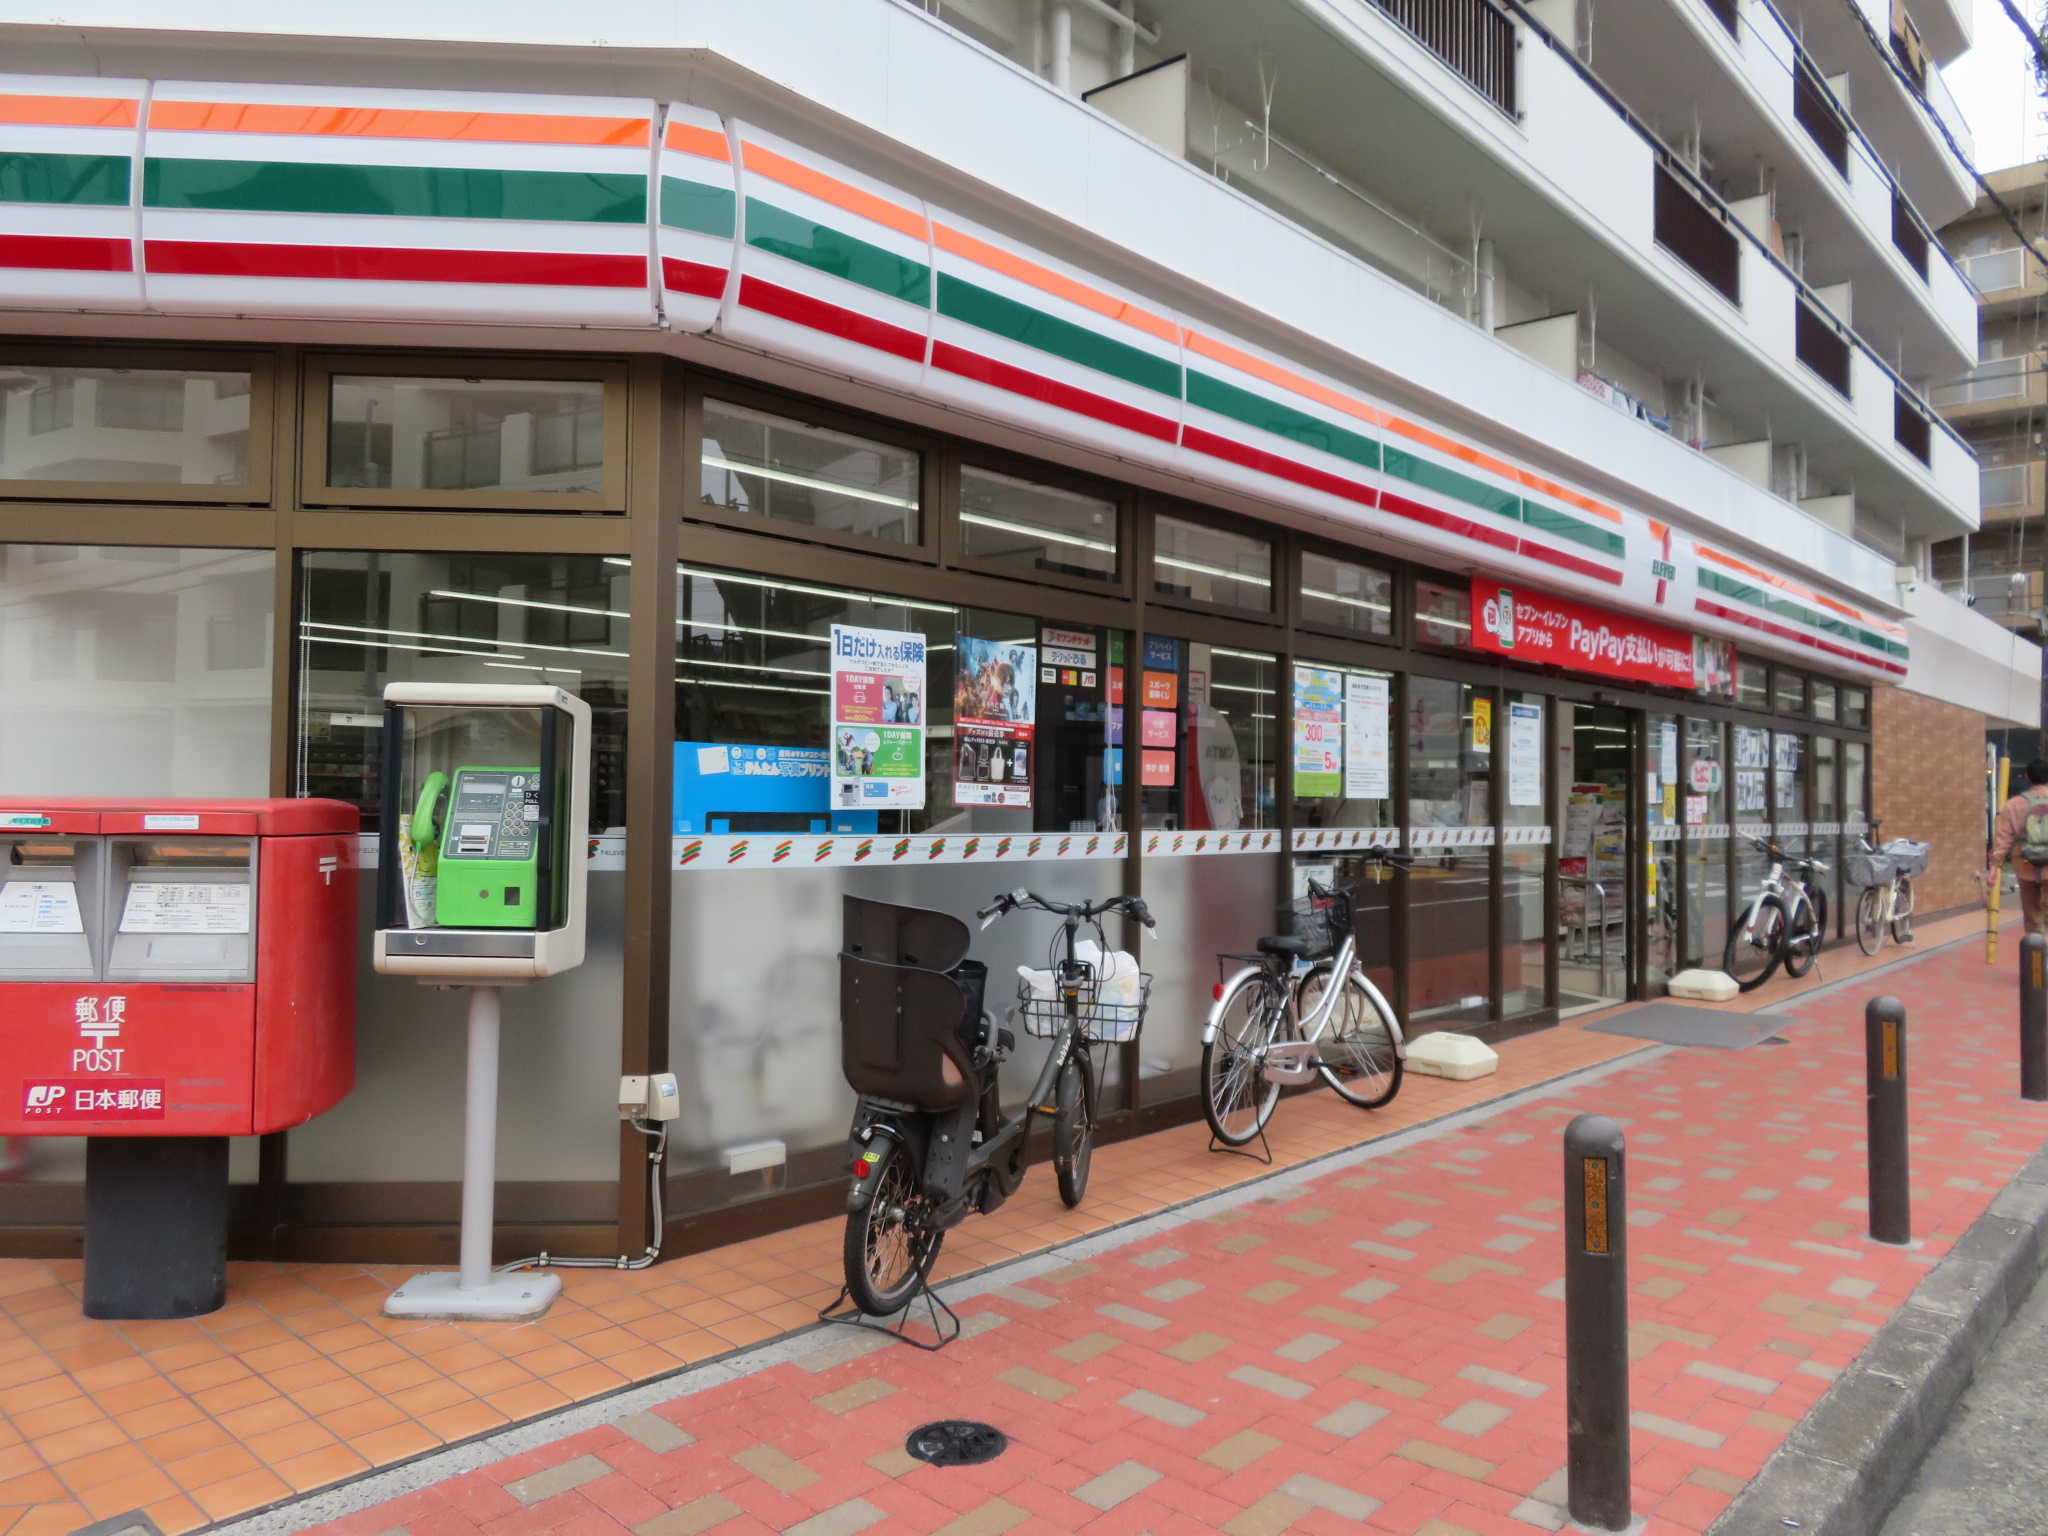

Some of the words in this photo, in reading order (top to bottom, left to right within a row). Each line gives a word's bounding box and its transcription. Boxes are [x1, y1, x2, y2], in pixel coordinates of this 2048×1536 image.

[1516, 603, 1569, 629] セブン-イレブン
[834, 629, 925, 663] 1日だけ入れる保険
[1517, 626, 1553, 648] アプリから
[1151, 651, 1172, 661] サービス
[1149, 681, 1171, 689] スポーツ
[1305, 724, 1323, 742] 300
[75, 996, 126, 1023] 郵便
[73, 1049, 124, 1072] POST
[75, 1089, 162, 1111] 日本郵便
